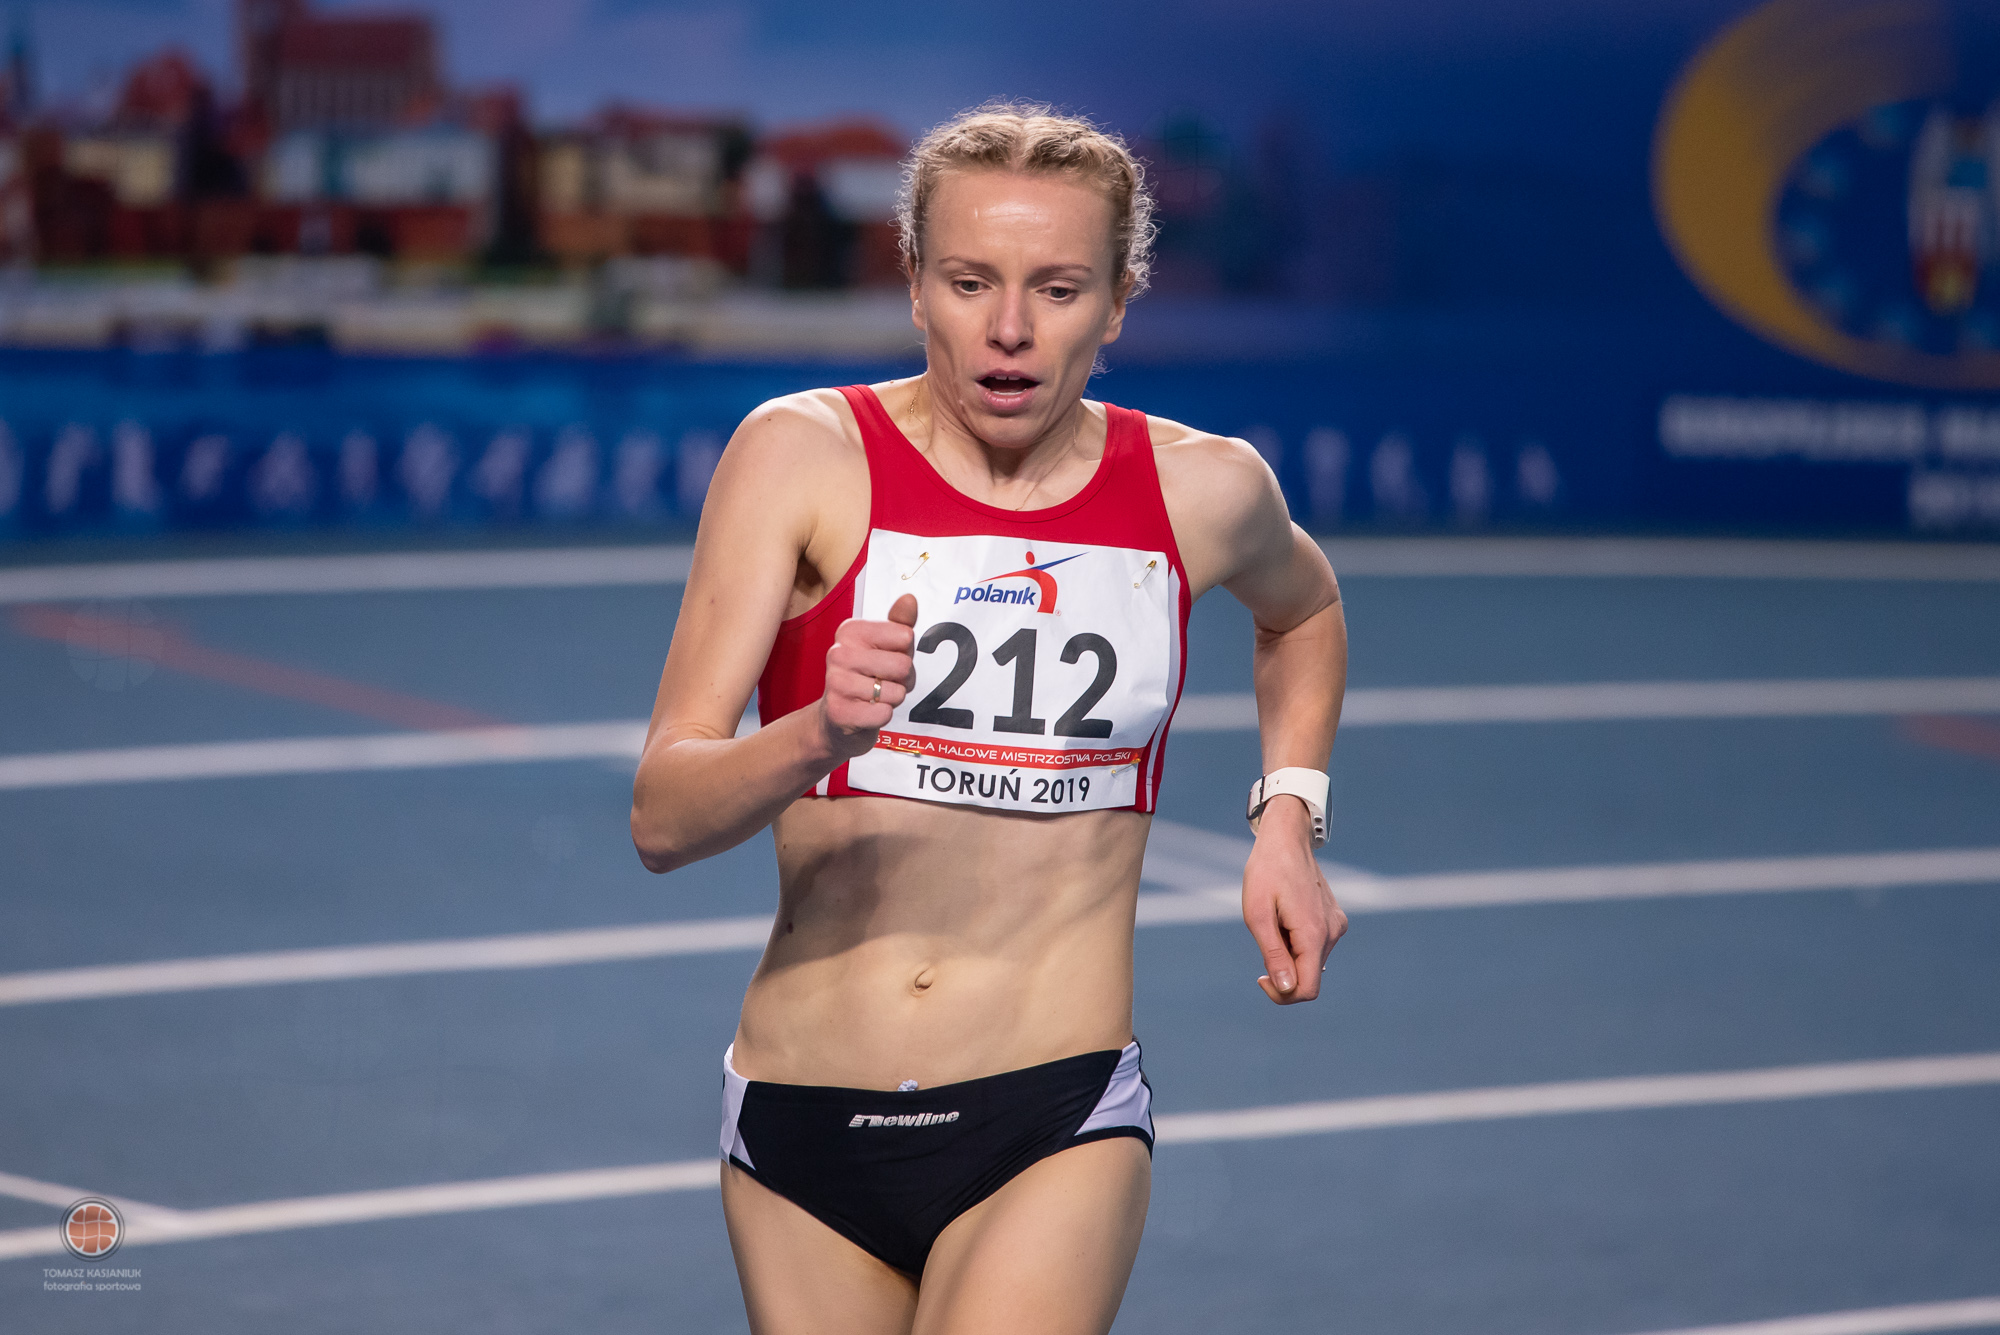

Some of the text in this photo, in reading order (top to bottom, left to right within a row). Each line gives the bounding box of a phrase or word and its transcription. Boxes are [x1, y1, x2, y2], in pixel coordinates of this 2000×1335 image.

[953, 583, 1037, 606] polanik
[908, 621, 1118, 738] 212
[898, 738, 936, 752] PZLA
[938, 744, 998, 760] HALOWE
[1000, 751, 1091, 765] MISTRZOSTWA
[1092, 752, 1131, 762] POLSKI
[916, 764, 1091, 805] TORUŃ 2019
[848, 1111, 960, 1128] newline
